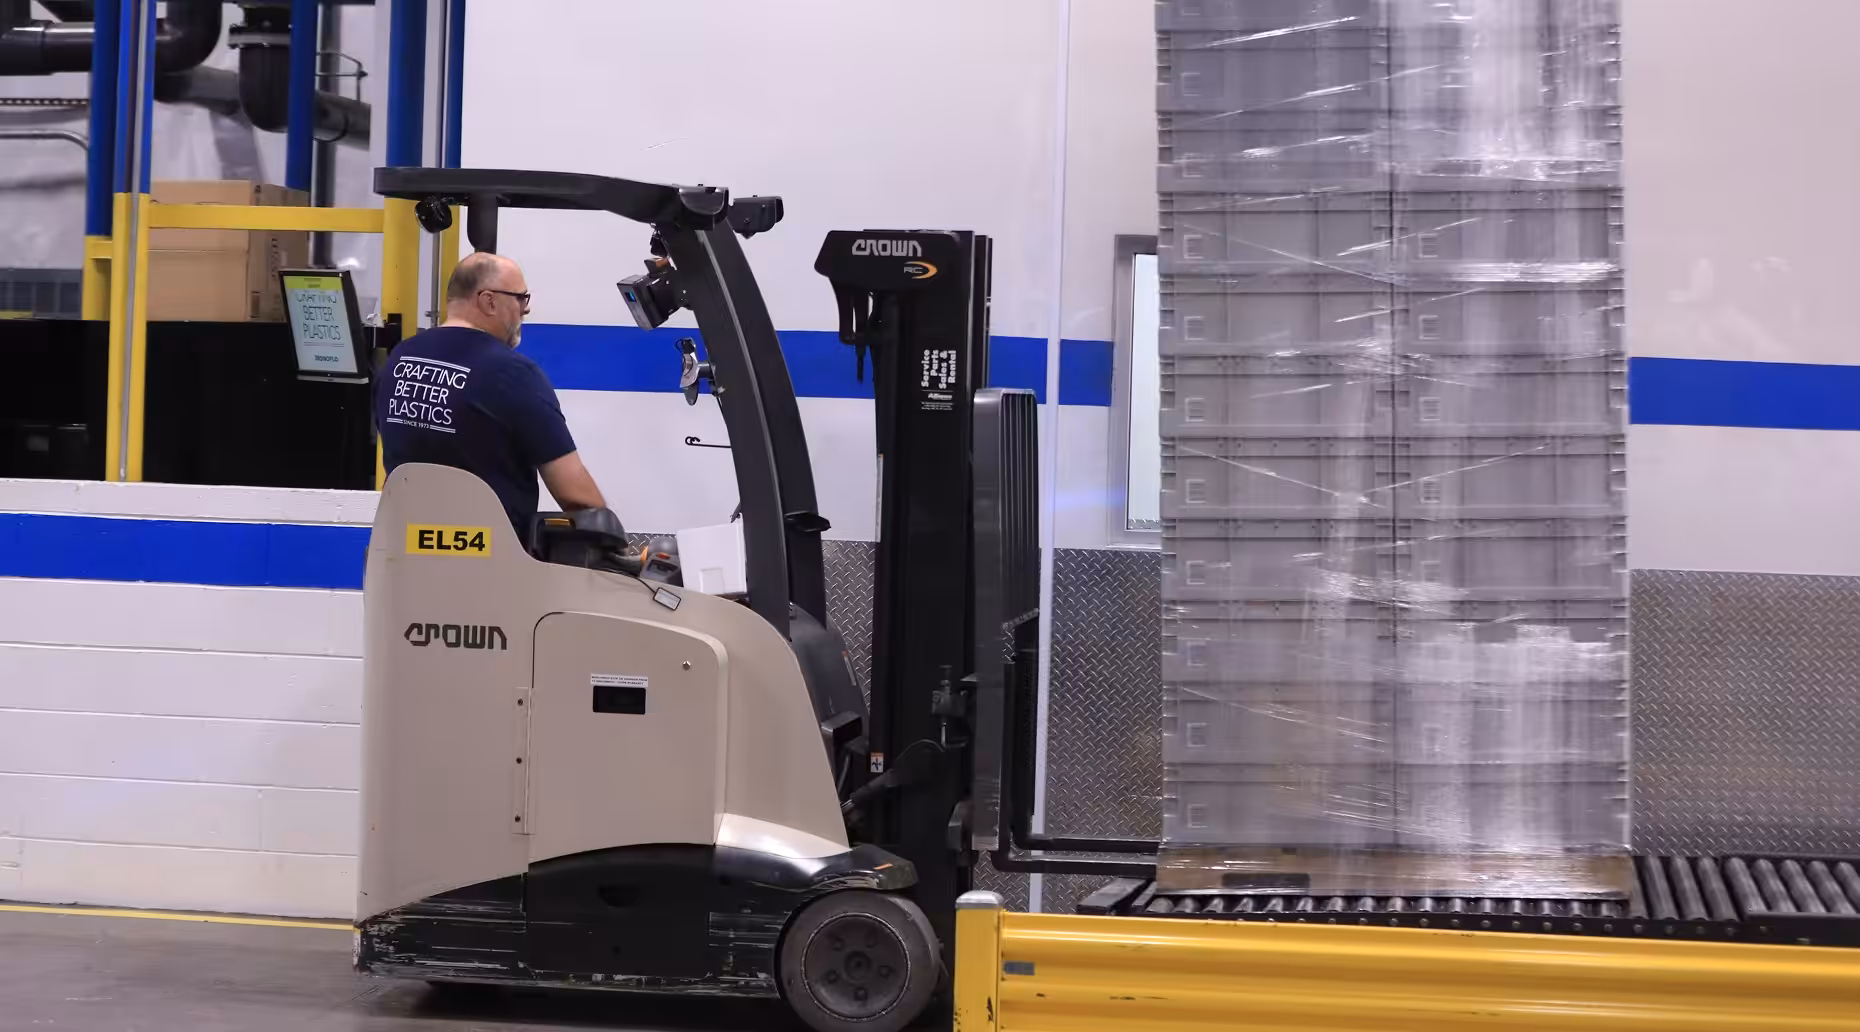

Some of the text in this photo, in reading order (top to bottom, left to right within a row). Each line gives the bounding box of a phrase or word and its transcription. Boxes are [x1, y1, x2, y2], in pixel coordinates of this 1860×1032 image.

[852, 239, 922, 257] CROWN
[903, 266, 924, 274] RC
[303, 305, 334, 322] BETTER
[303, 323, 341, 341] PLASTICS
[393, 362, 467, 389] CRAFTING
[920, 349, 930, 388] Service
[930, 350, 939, 377] Parts
[938, 362, 948, 389] Sales
[947, 350, 957, 384] Rental
[394, 380, 449, 405] BETTER
[388, 398, 453, 425] PLASTICS
[403, 419, 430, 430] SINCE 1973
[418, 529, 485, 552] EL54
[403, 622, 508, 650] CROWN
